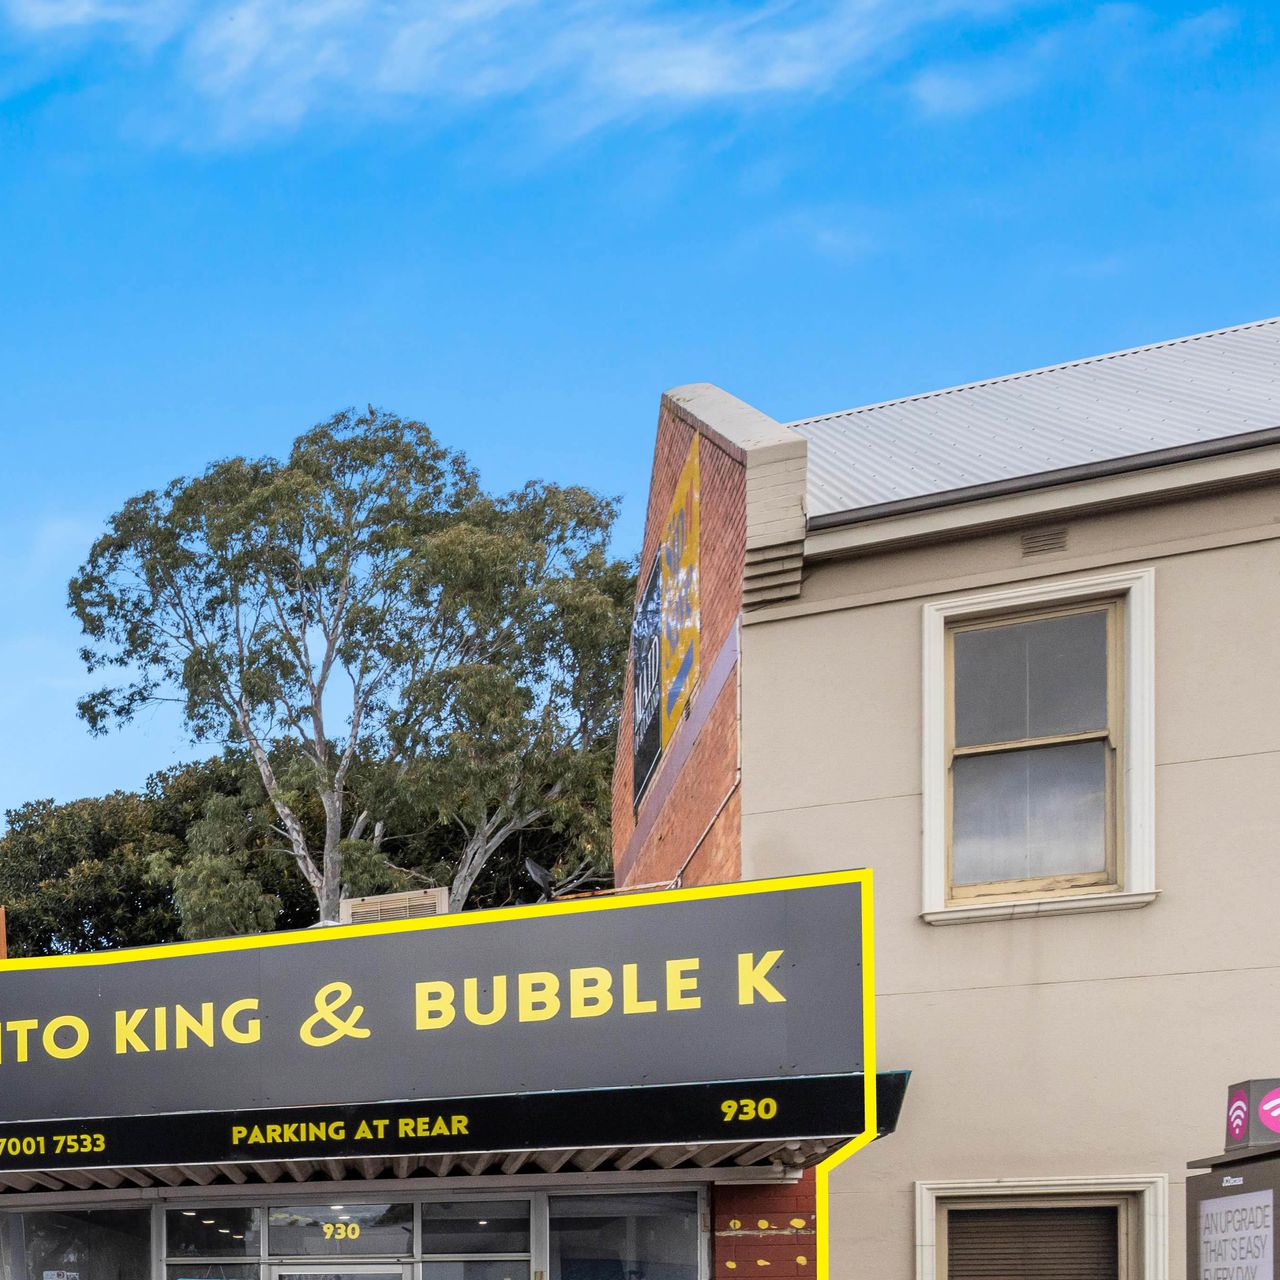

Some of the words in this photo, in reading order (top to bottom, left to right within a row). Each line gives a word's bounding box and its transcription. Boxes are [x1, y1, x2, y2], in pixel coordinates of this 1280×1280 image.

[115, 998, 261, 1055] KING
[299, 981, 371, 1048] &
[415, 957, 702, 1031] BUBBLE
[737, 949, 787, 1006] K
[721, 1098, 778, 1122] 930
[52, 1133, 106, 1154] 7533
[232, 1121, 345, 1145] PARKING
[354, 1119, 389, 1140] AT
[398, 1115, 469, 1138] REAR
[322, 1223, 360, 1240] 930
[1203, 1212, 1219, 1235] AN
[1220, 1205, 1271, 1233] UPGRADE
[1203, 1238, 1237, 1264] THAT'S
[1239, 1235, 1268, 1260] EASY
